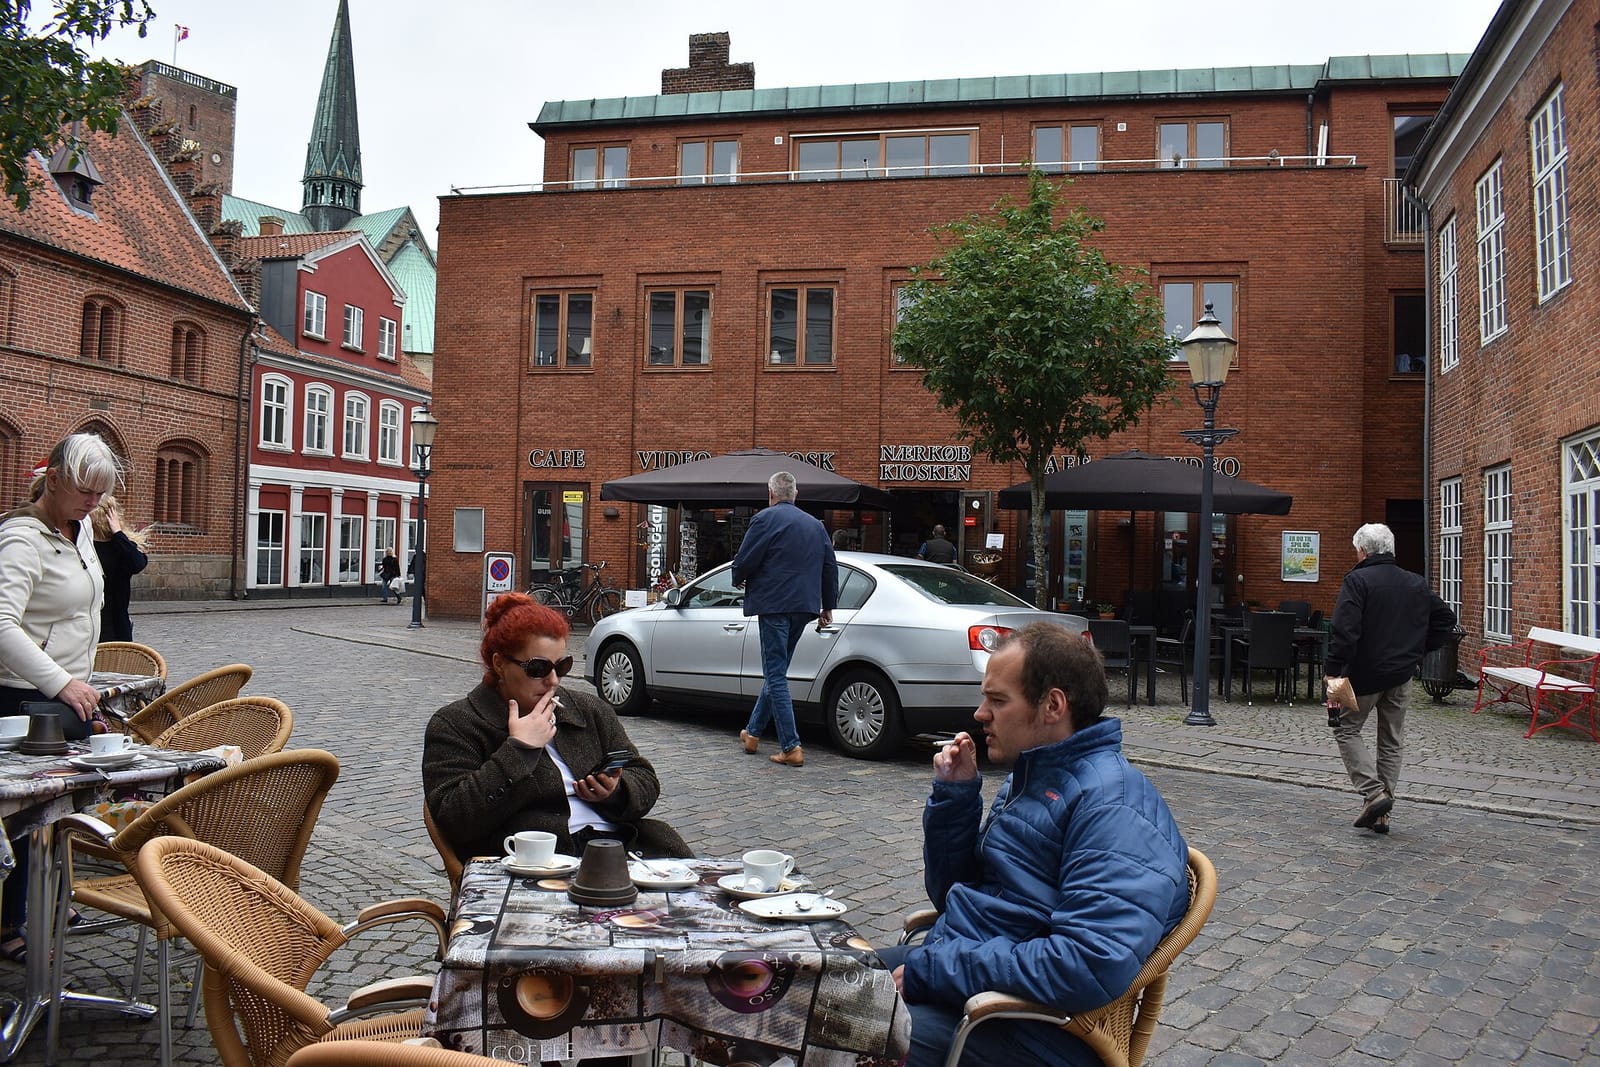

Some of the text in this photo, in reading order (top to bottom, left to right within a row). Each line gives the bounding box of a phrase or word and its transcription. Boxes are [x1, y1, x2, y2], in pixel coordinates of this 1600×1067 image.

[528, 448, 585, 468] CAFE
[880, 444, 971, 462] NÆRKØB
[880, 463, 971, 481] KIOSKEN
